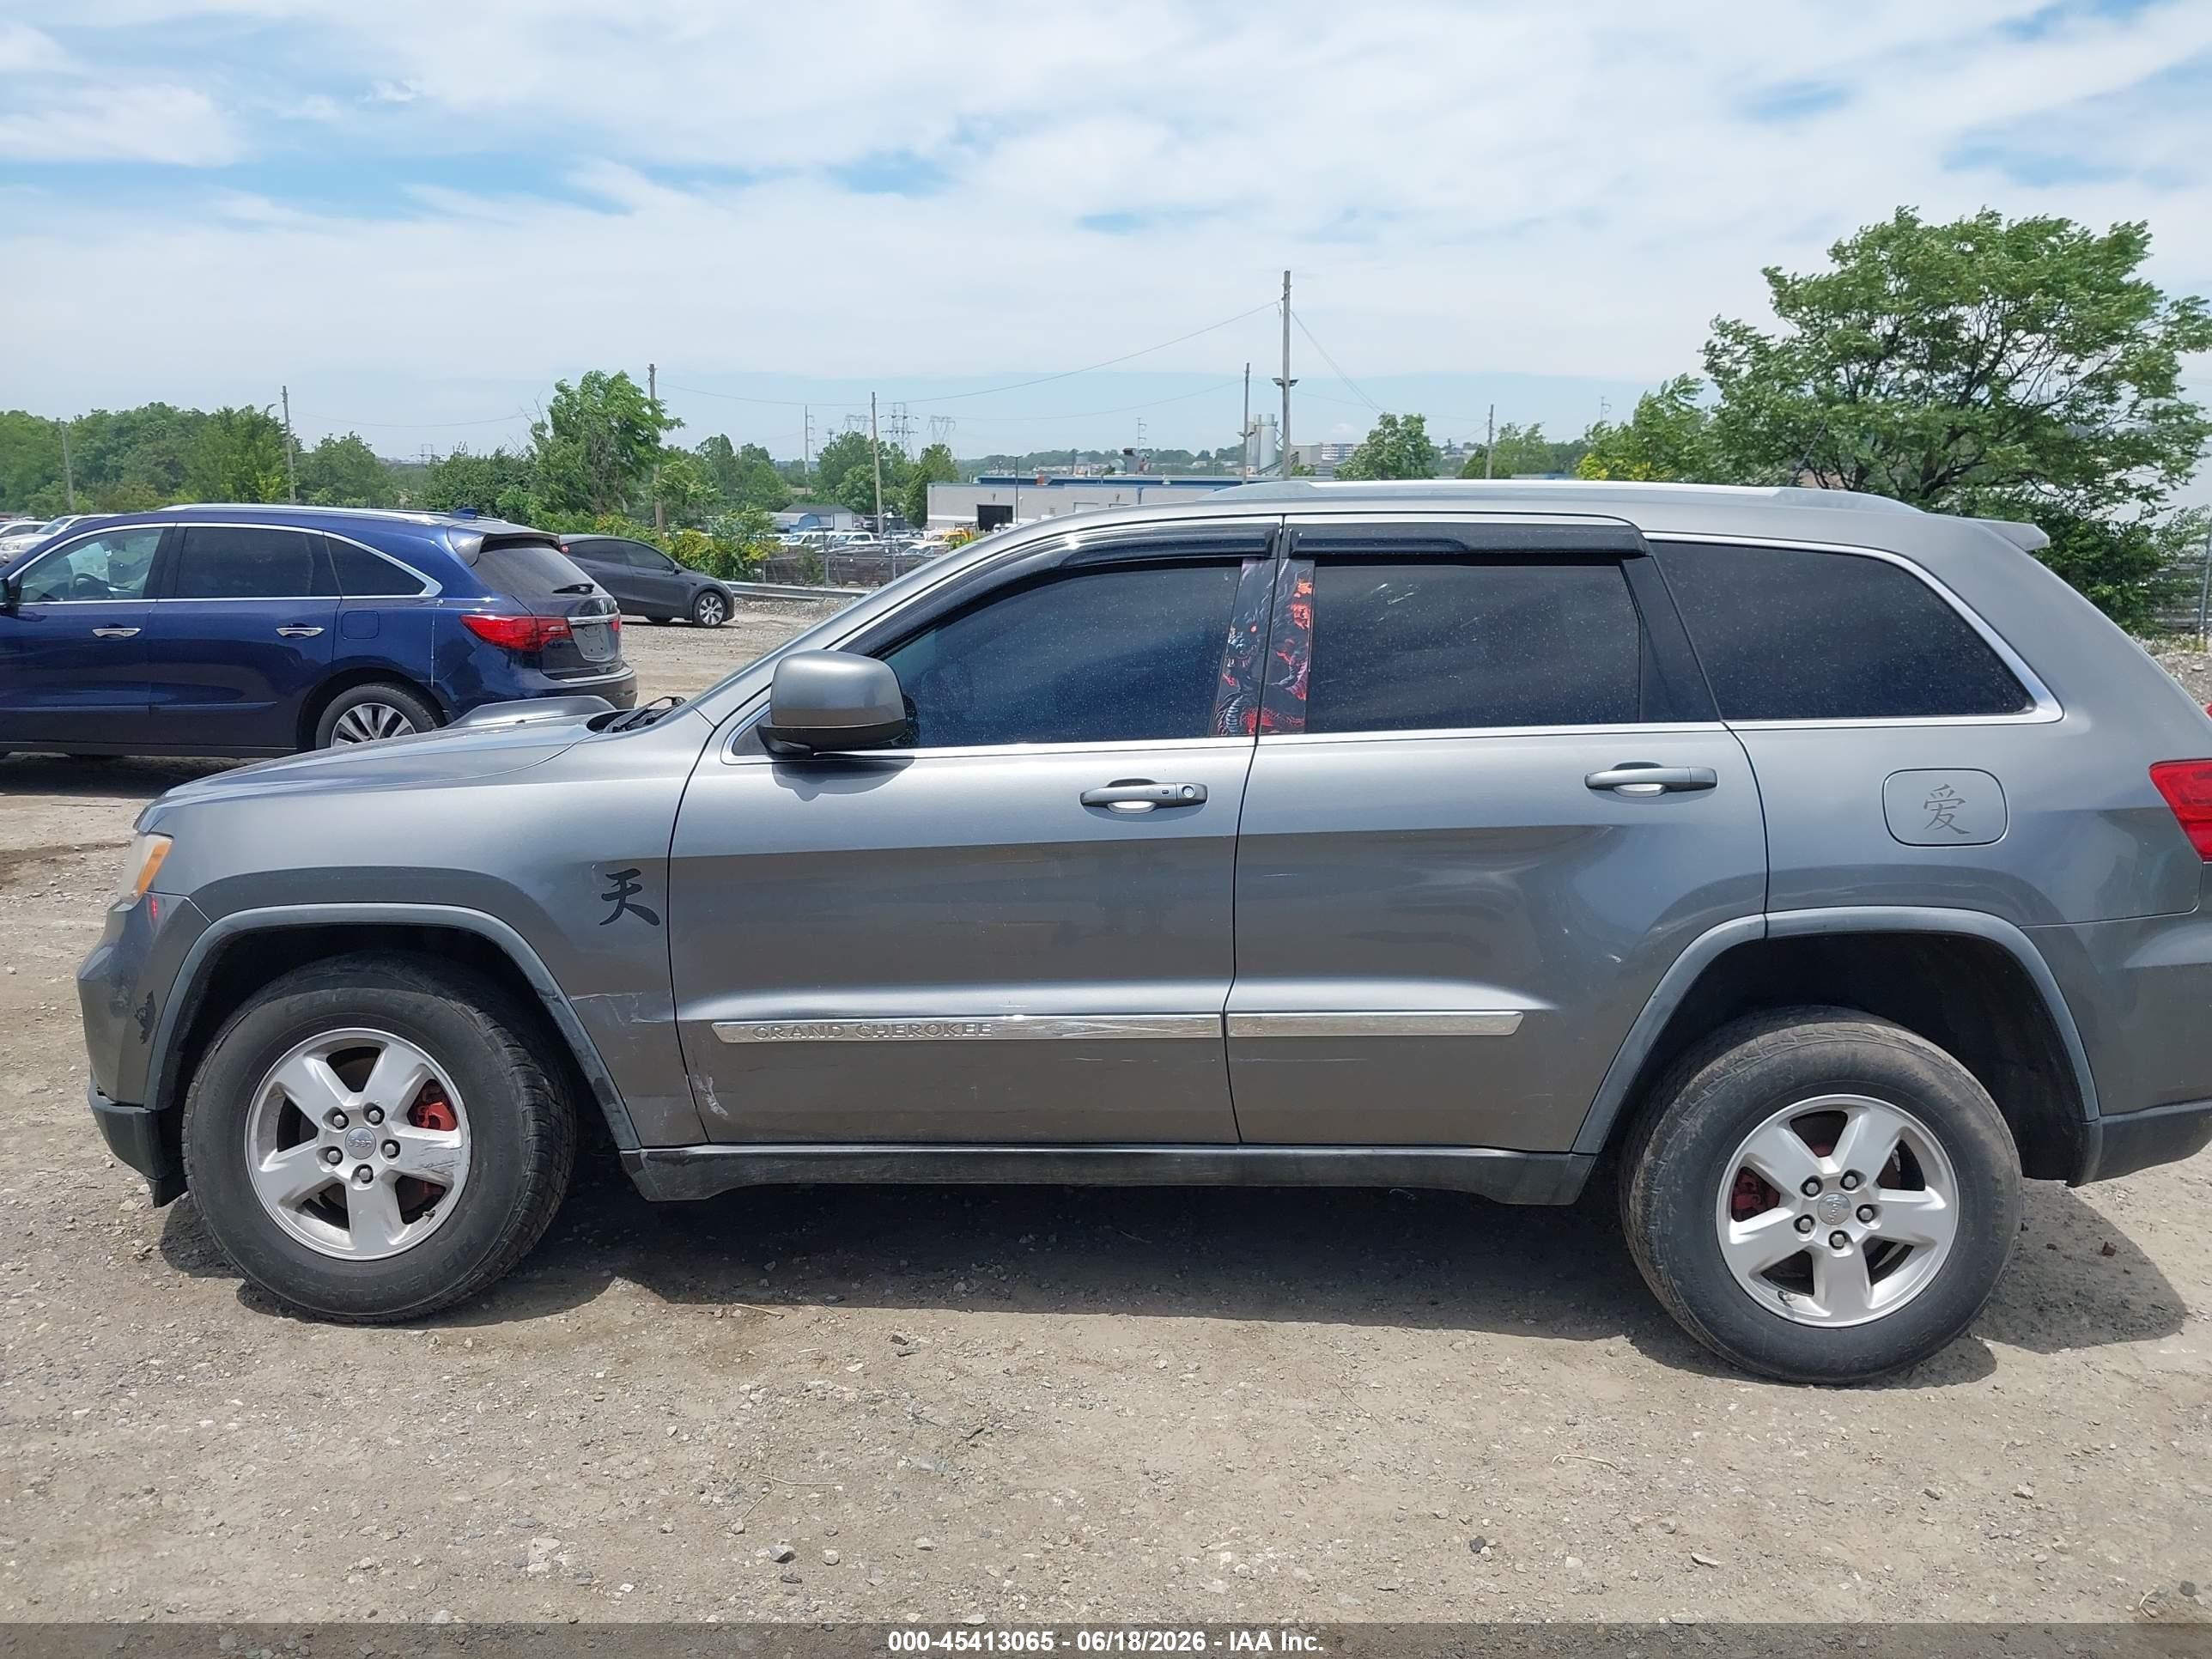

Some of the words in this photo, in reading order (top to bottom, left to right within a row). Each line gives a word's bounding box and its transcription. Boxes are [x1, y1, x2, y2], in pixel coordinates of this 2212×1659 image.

[1923, 783, 1972, 835] 爱
[599, 867, 660, 927] 天
[752, 1024, 846, 1040] GRAND
[855, 1023, 993, 1038] CHEROKEE
